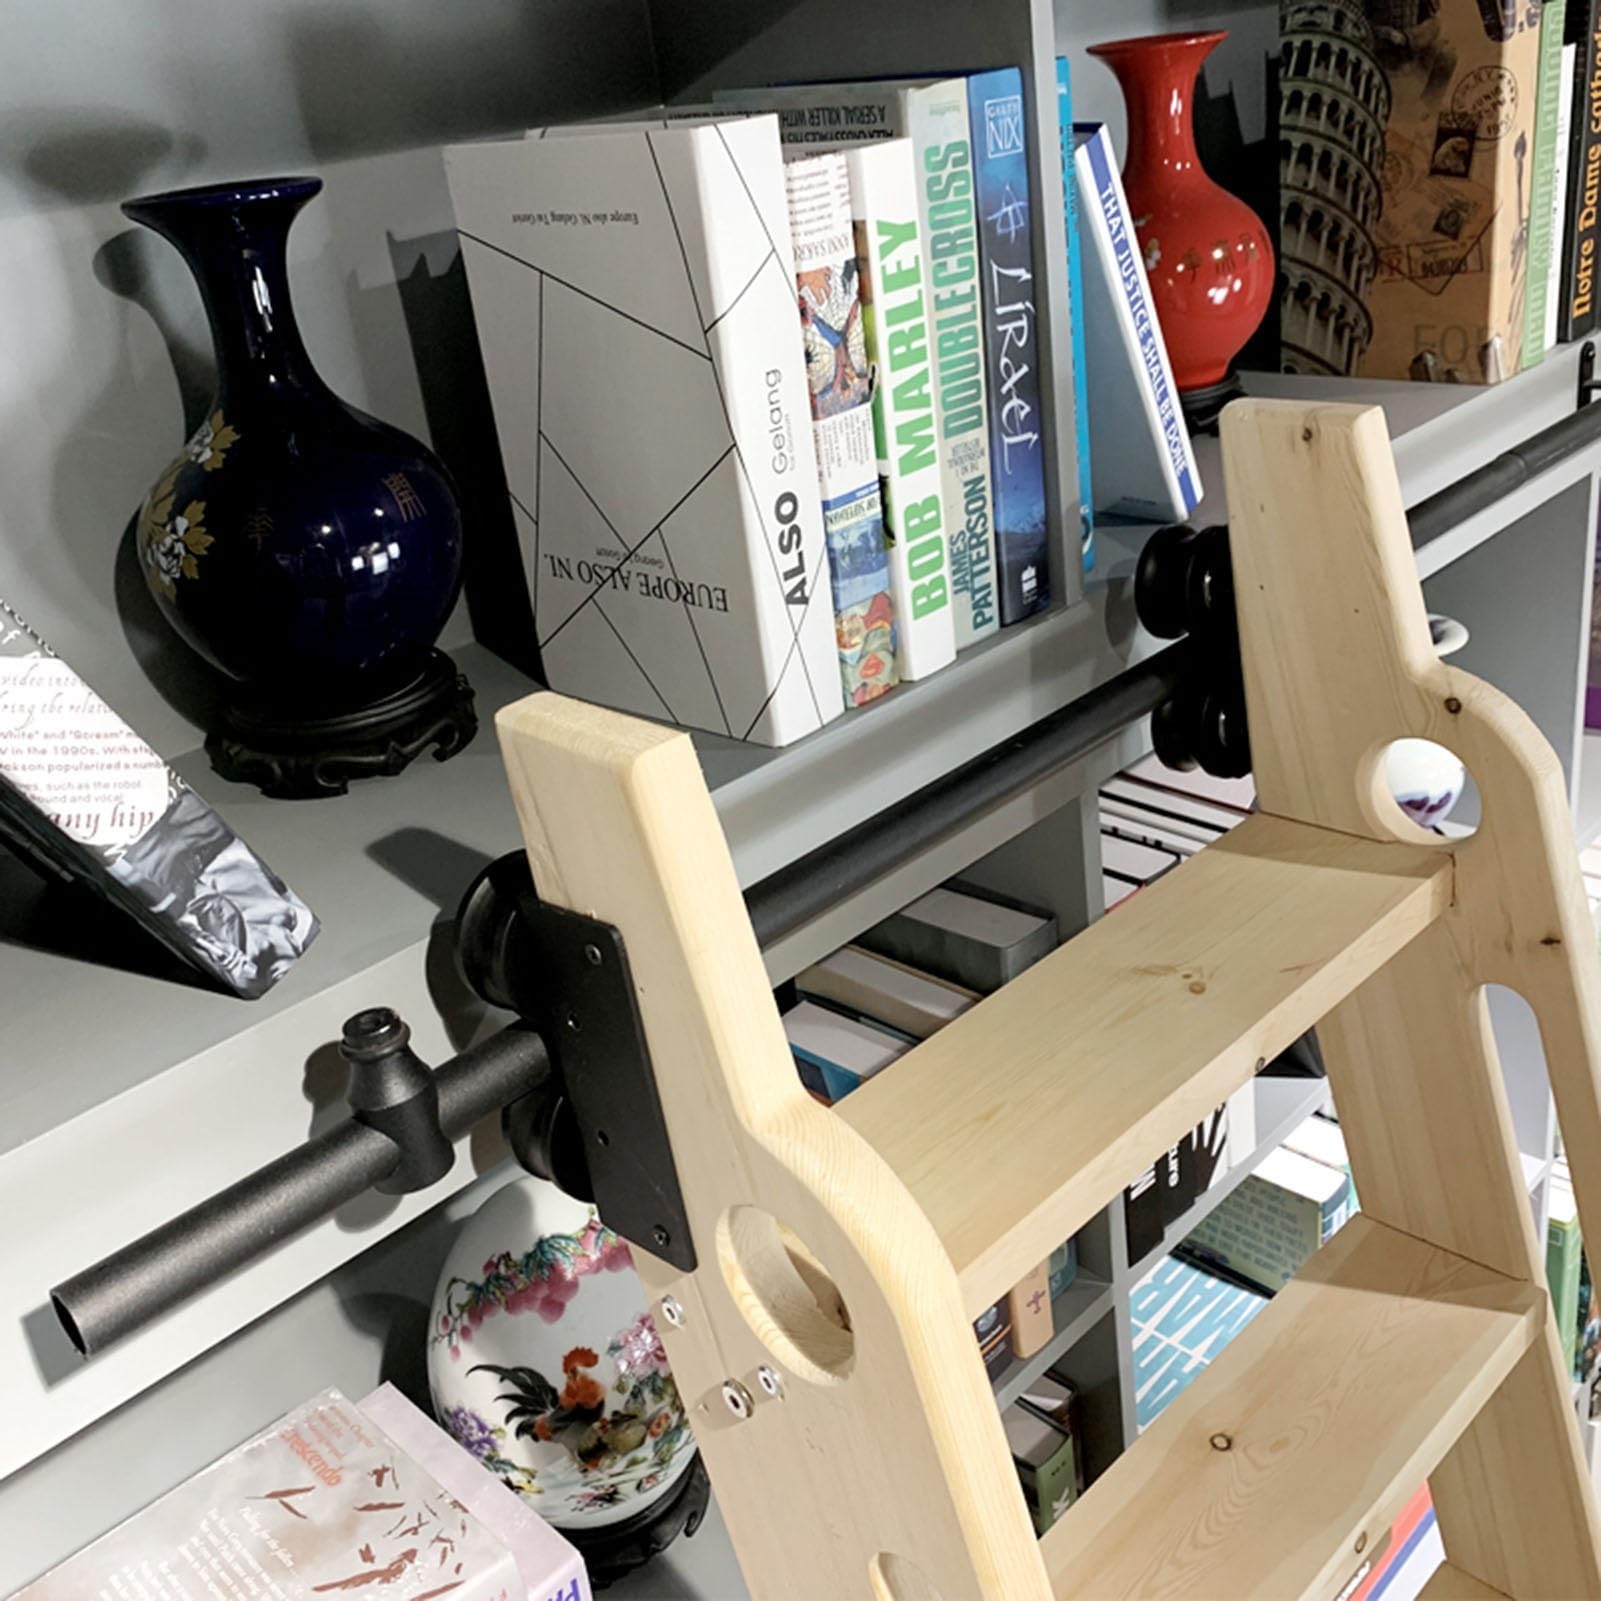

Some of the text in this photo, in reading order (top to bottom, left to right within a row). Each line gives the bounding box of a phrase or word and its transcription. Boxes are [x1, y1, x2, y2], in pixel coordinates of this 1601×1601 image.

[1101, 182, 1188, 478] THAT JUSTICE SHALL BE DONE
[765, 368, 789, 476] Gelang
[876, 219, 948, 621] BOB MARLEY
[577, 559, 633, 591] ALSO
[775, 491, 810, 606] ALSO
[950, 529, 970, 596] JAMES
[963, 475, 995, 631] PATTERSON
[636, 572, 729, 613] EUROPE
[27, 745, 48, 755] the
[43, 729, 67, 740] and
[47, 760, 122, 777] popularized
